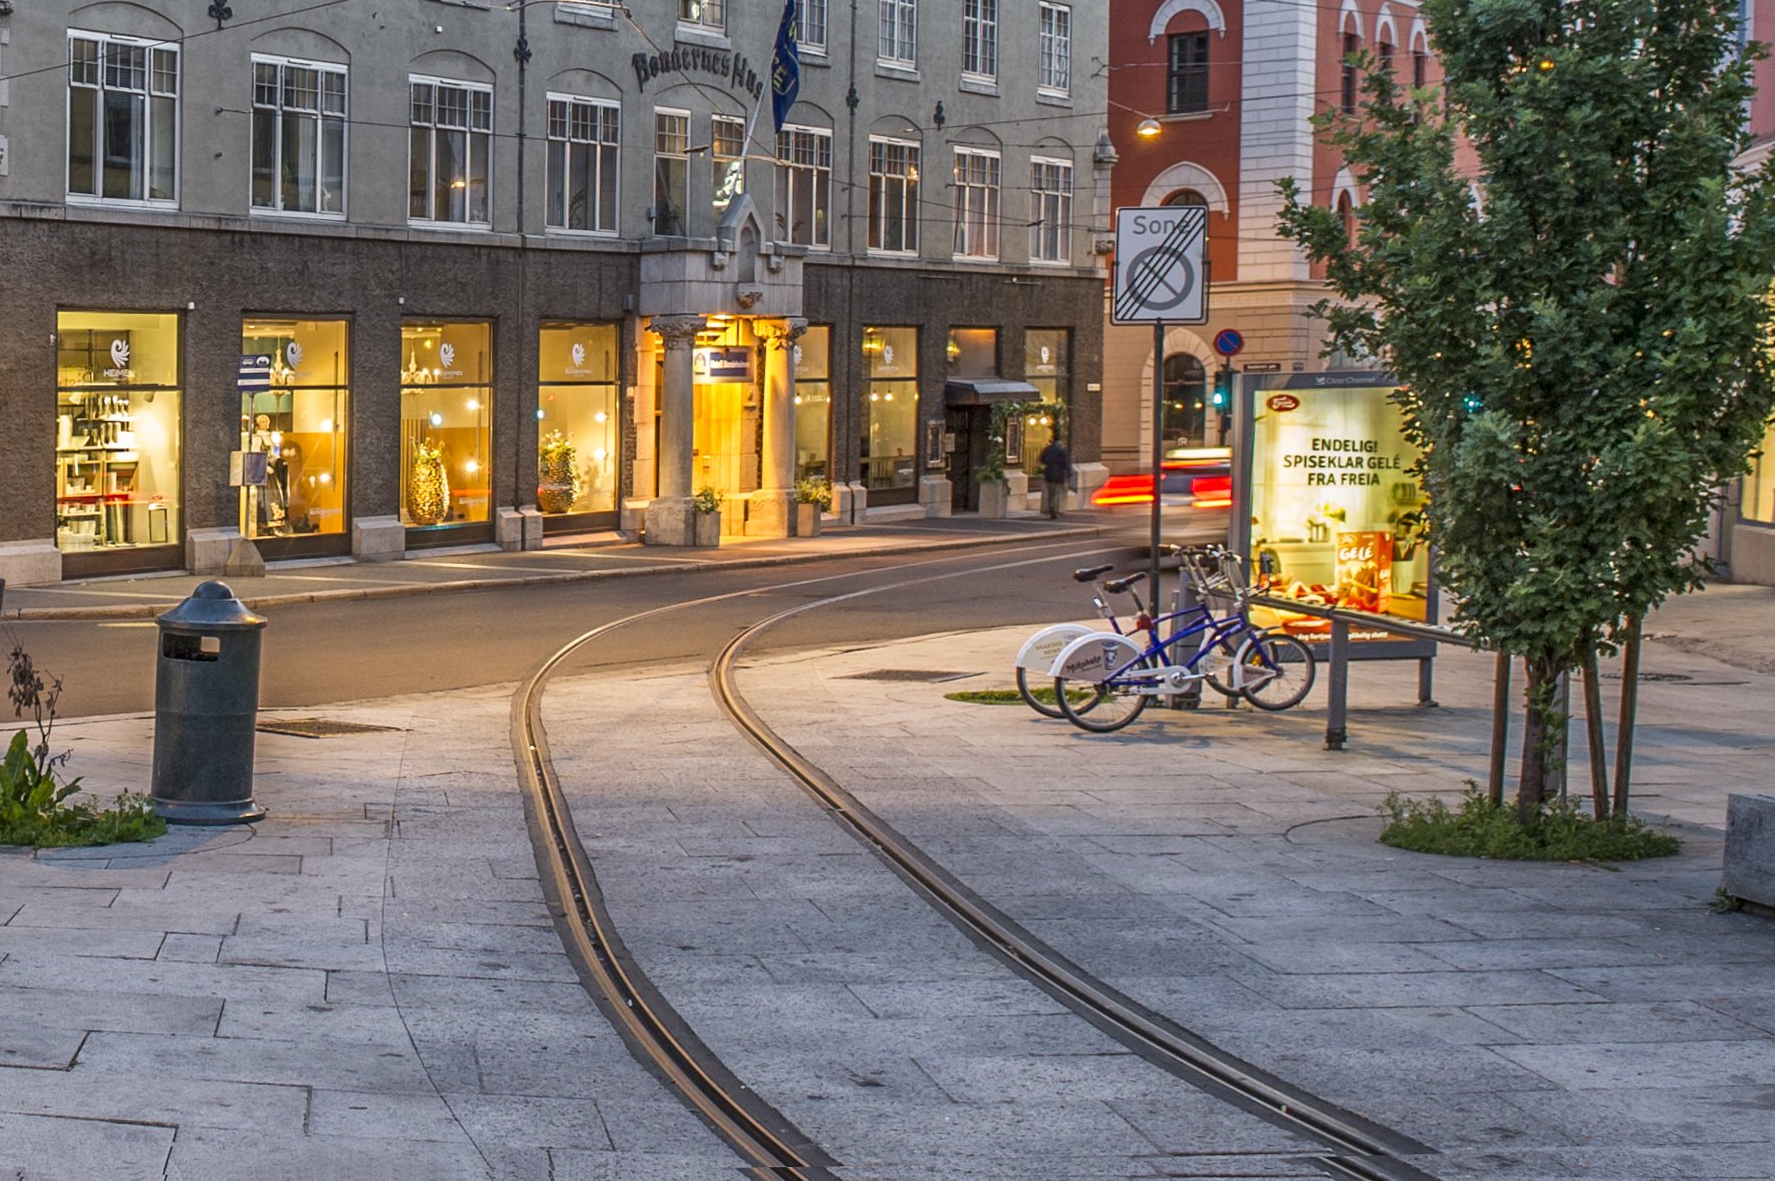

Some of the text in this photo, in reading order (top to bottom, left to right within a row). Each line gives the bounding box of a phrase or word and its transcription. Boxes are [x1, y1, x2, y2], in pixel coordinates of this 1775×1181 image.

[1133, 215, 1190, 235] Sone
[1312, 438, 1378, 453] ENDELIG!
[1284, 454, 1401, 469] SPISEKLAR GELÉ
[1307, 473, 1380, 486] FRA FREIA
